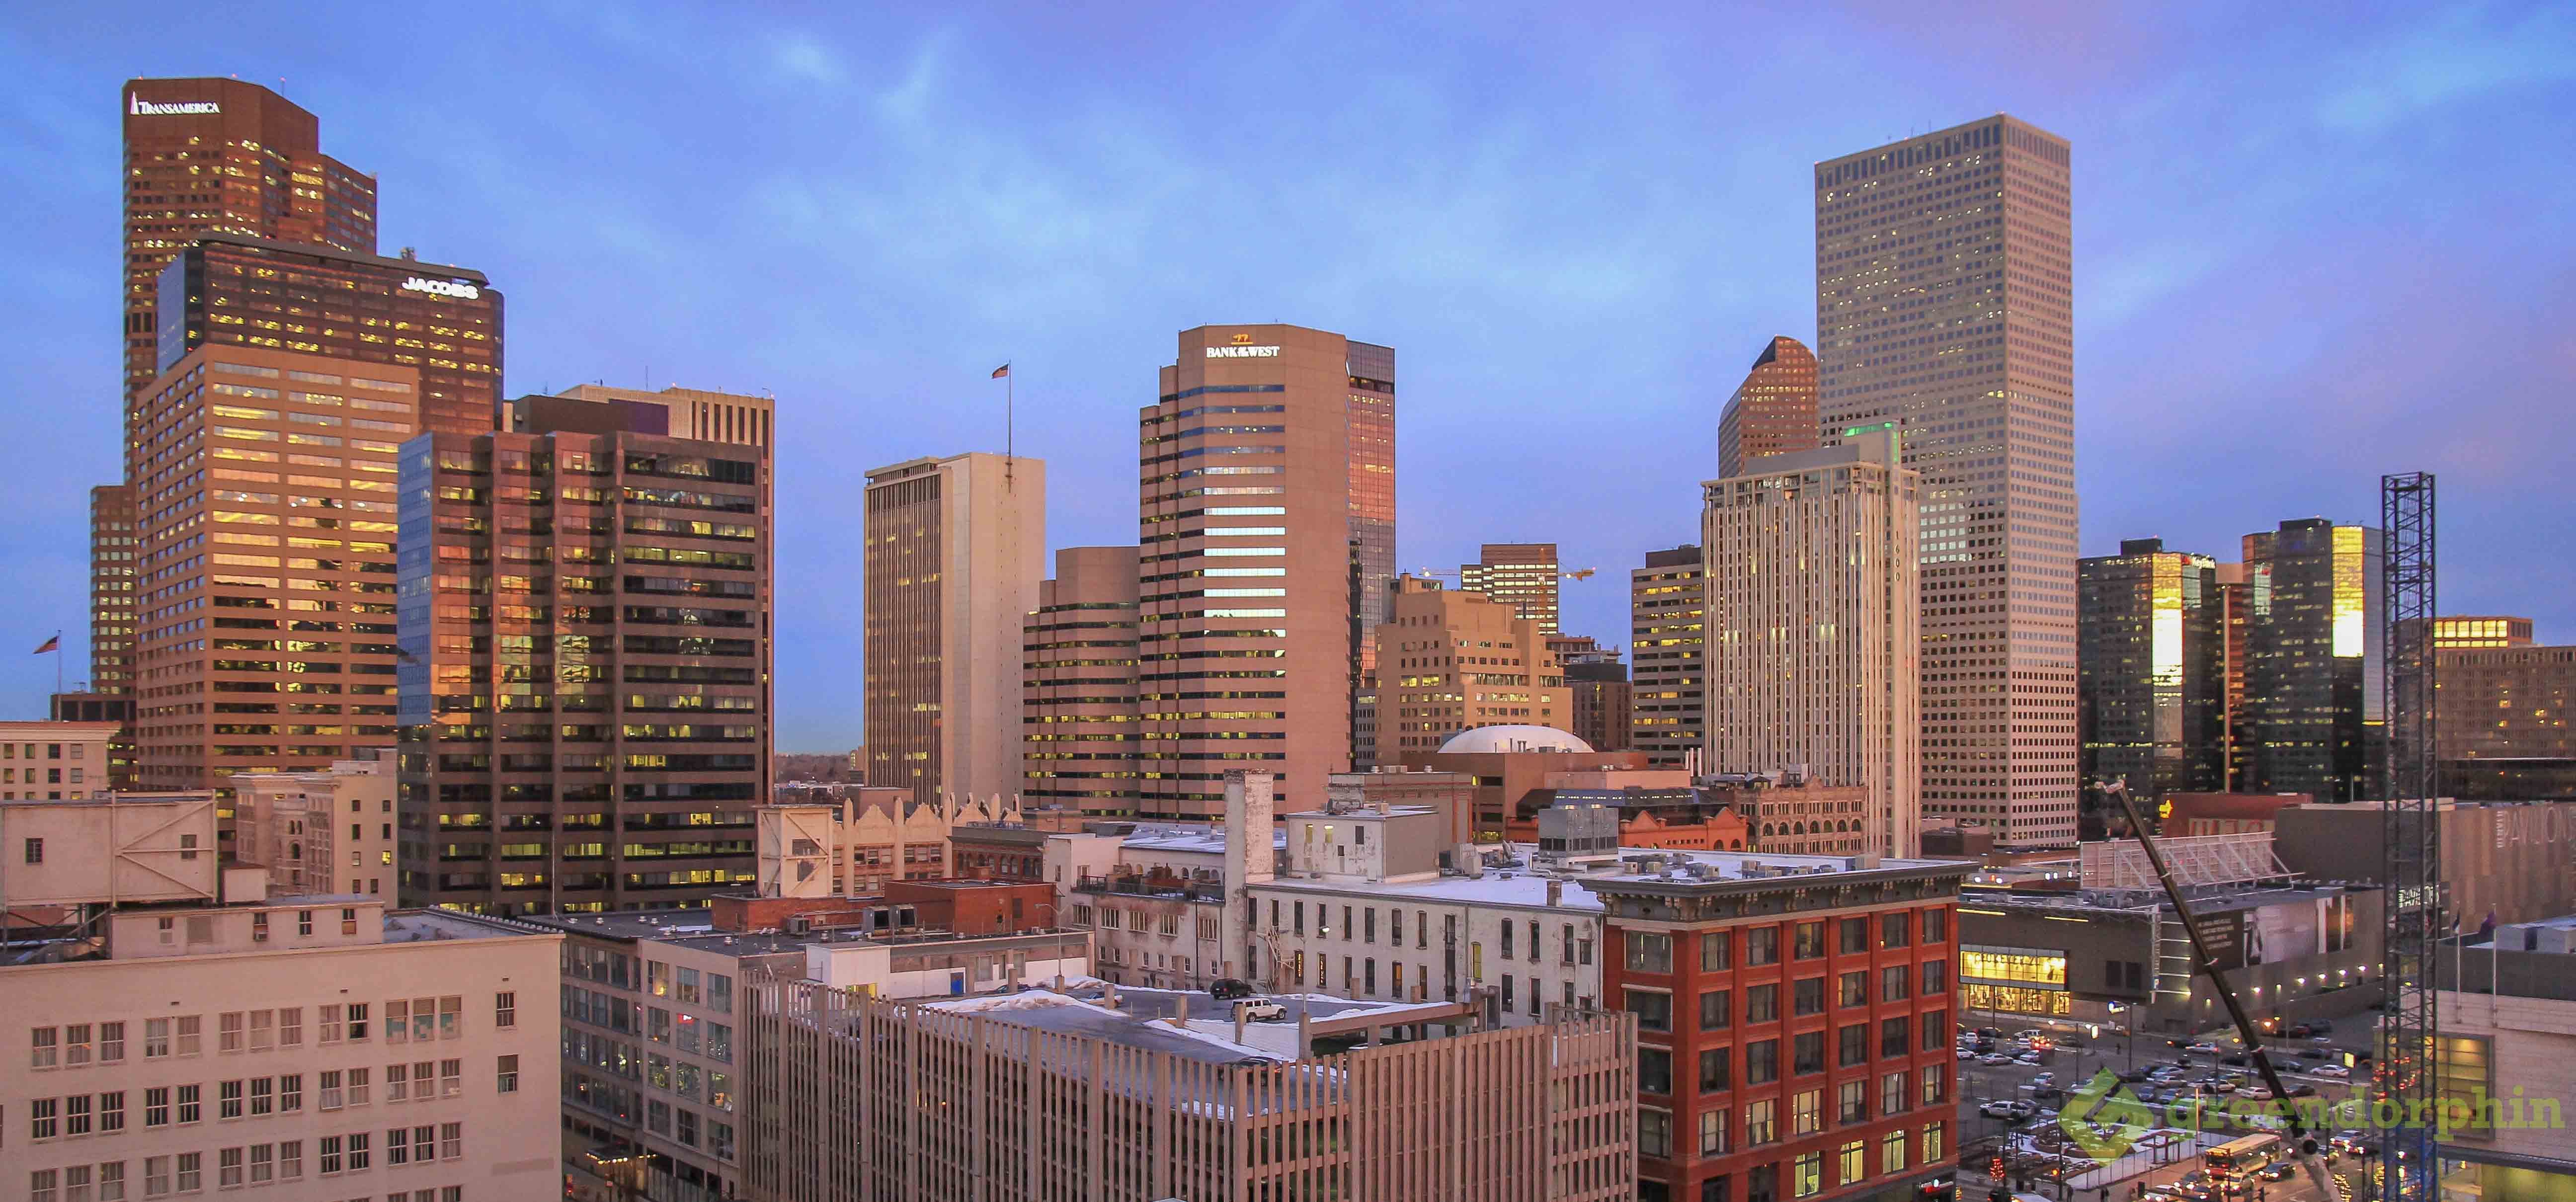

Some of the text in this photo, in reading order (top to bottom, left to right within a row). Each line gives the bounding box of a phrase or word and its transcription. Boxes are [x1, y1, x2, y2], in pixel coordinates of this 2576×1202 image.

[139, 101, 221, 115] TRANSAMERICA
[402, 277, 479, 300] JACOBS
[1207, 347, 1237, 358] BANK
[1247, 346, 1280, 357] WEST
